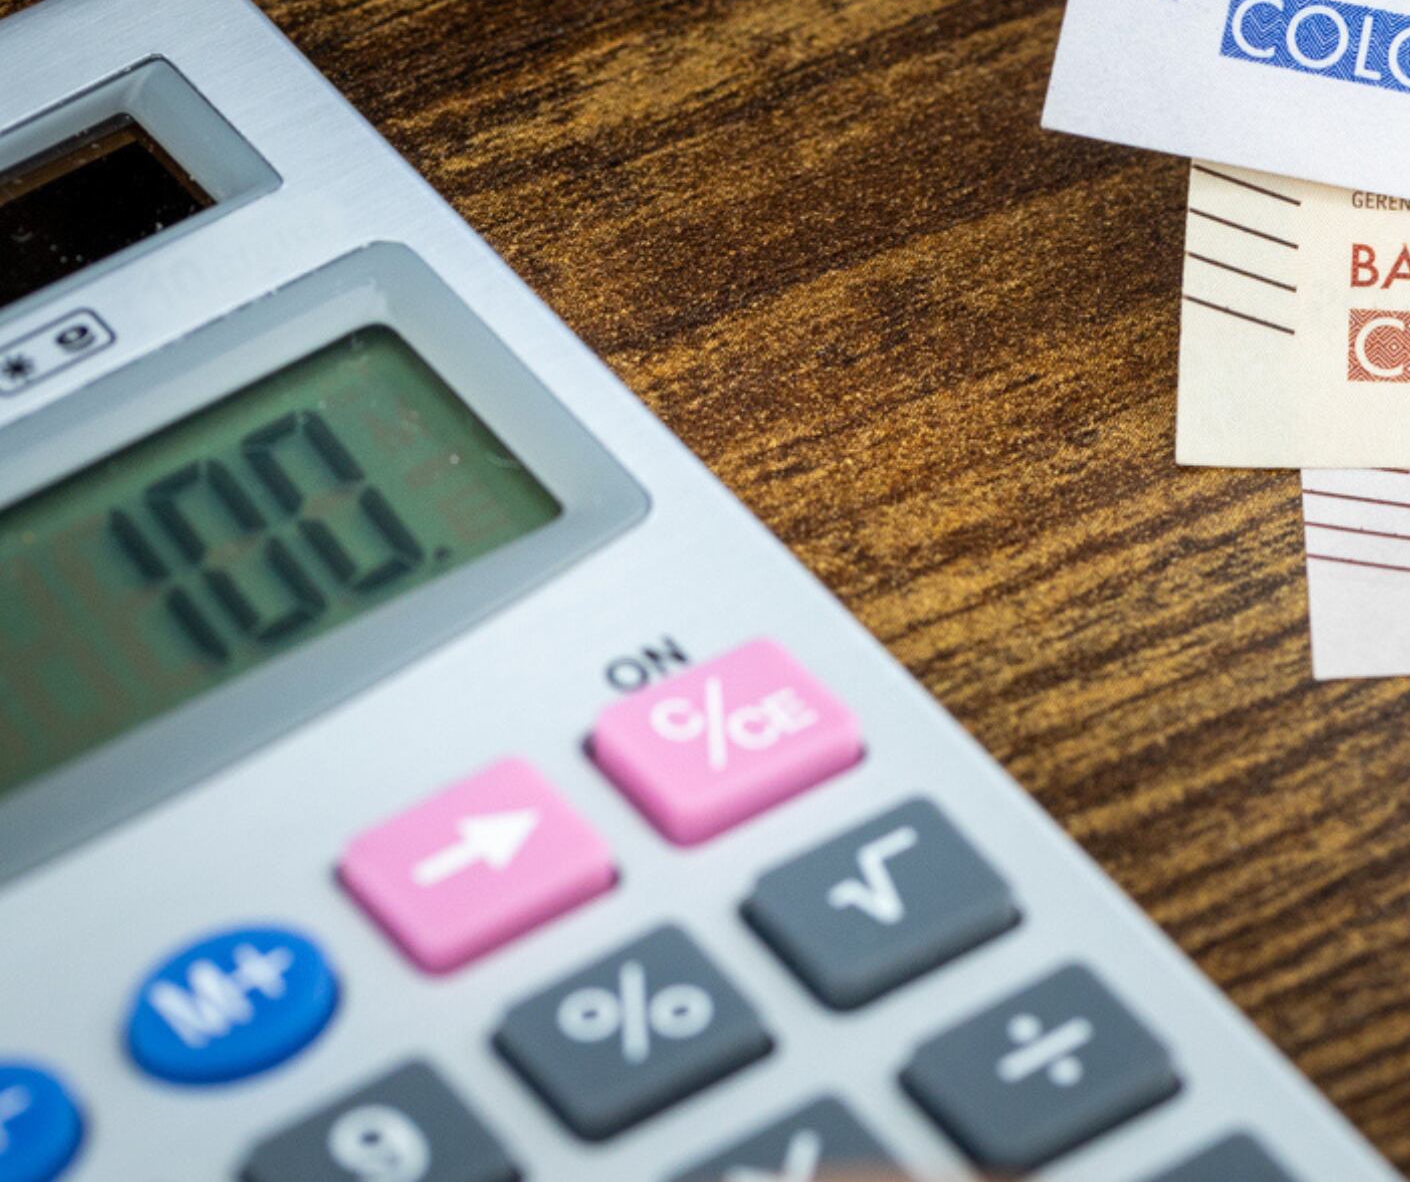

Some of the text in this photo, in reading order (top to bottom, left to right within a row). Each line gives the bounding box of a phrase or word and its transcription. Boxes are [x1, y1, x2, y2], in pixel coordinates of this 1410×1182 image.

[608, 634, 690, 693] ON
[649, 673, 818, 772] C/CE
[148, 942, 296, 1050] M+
